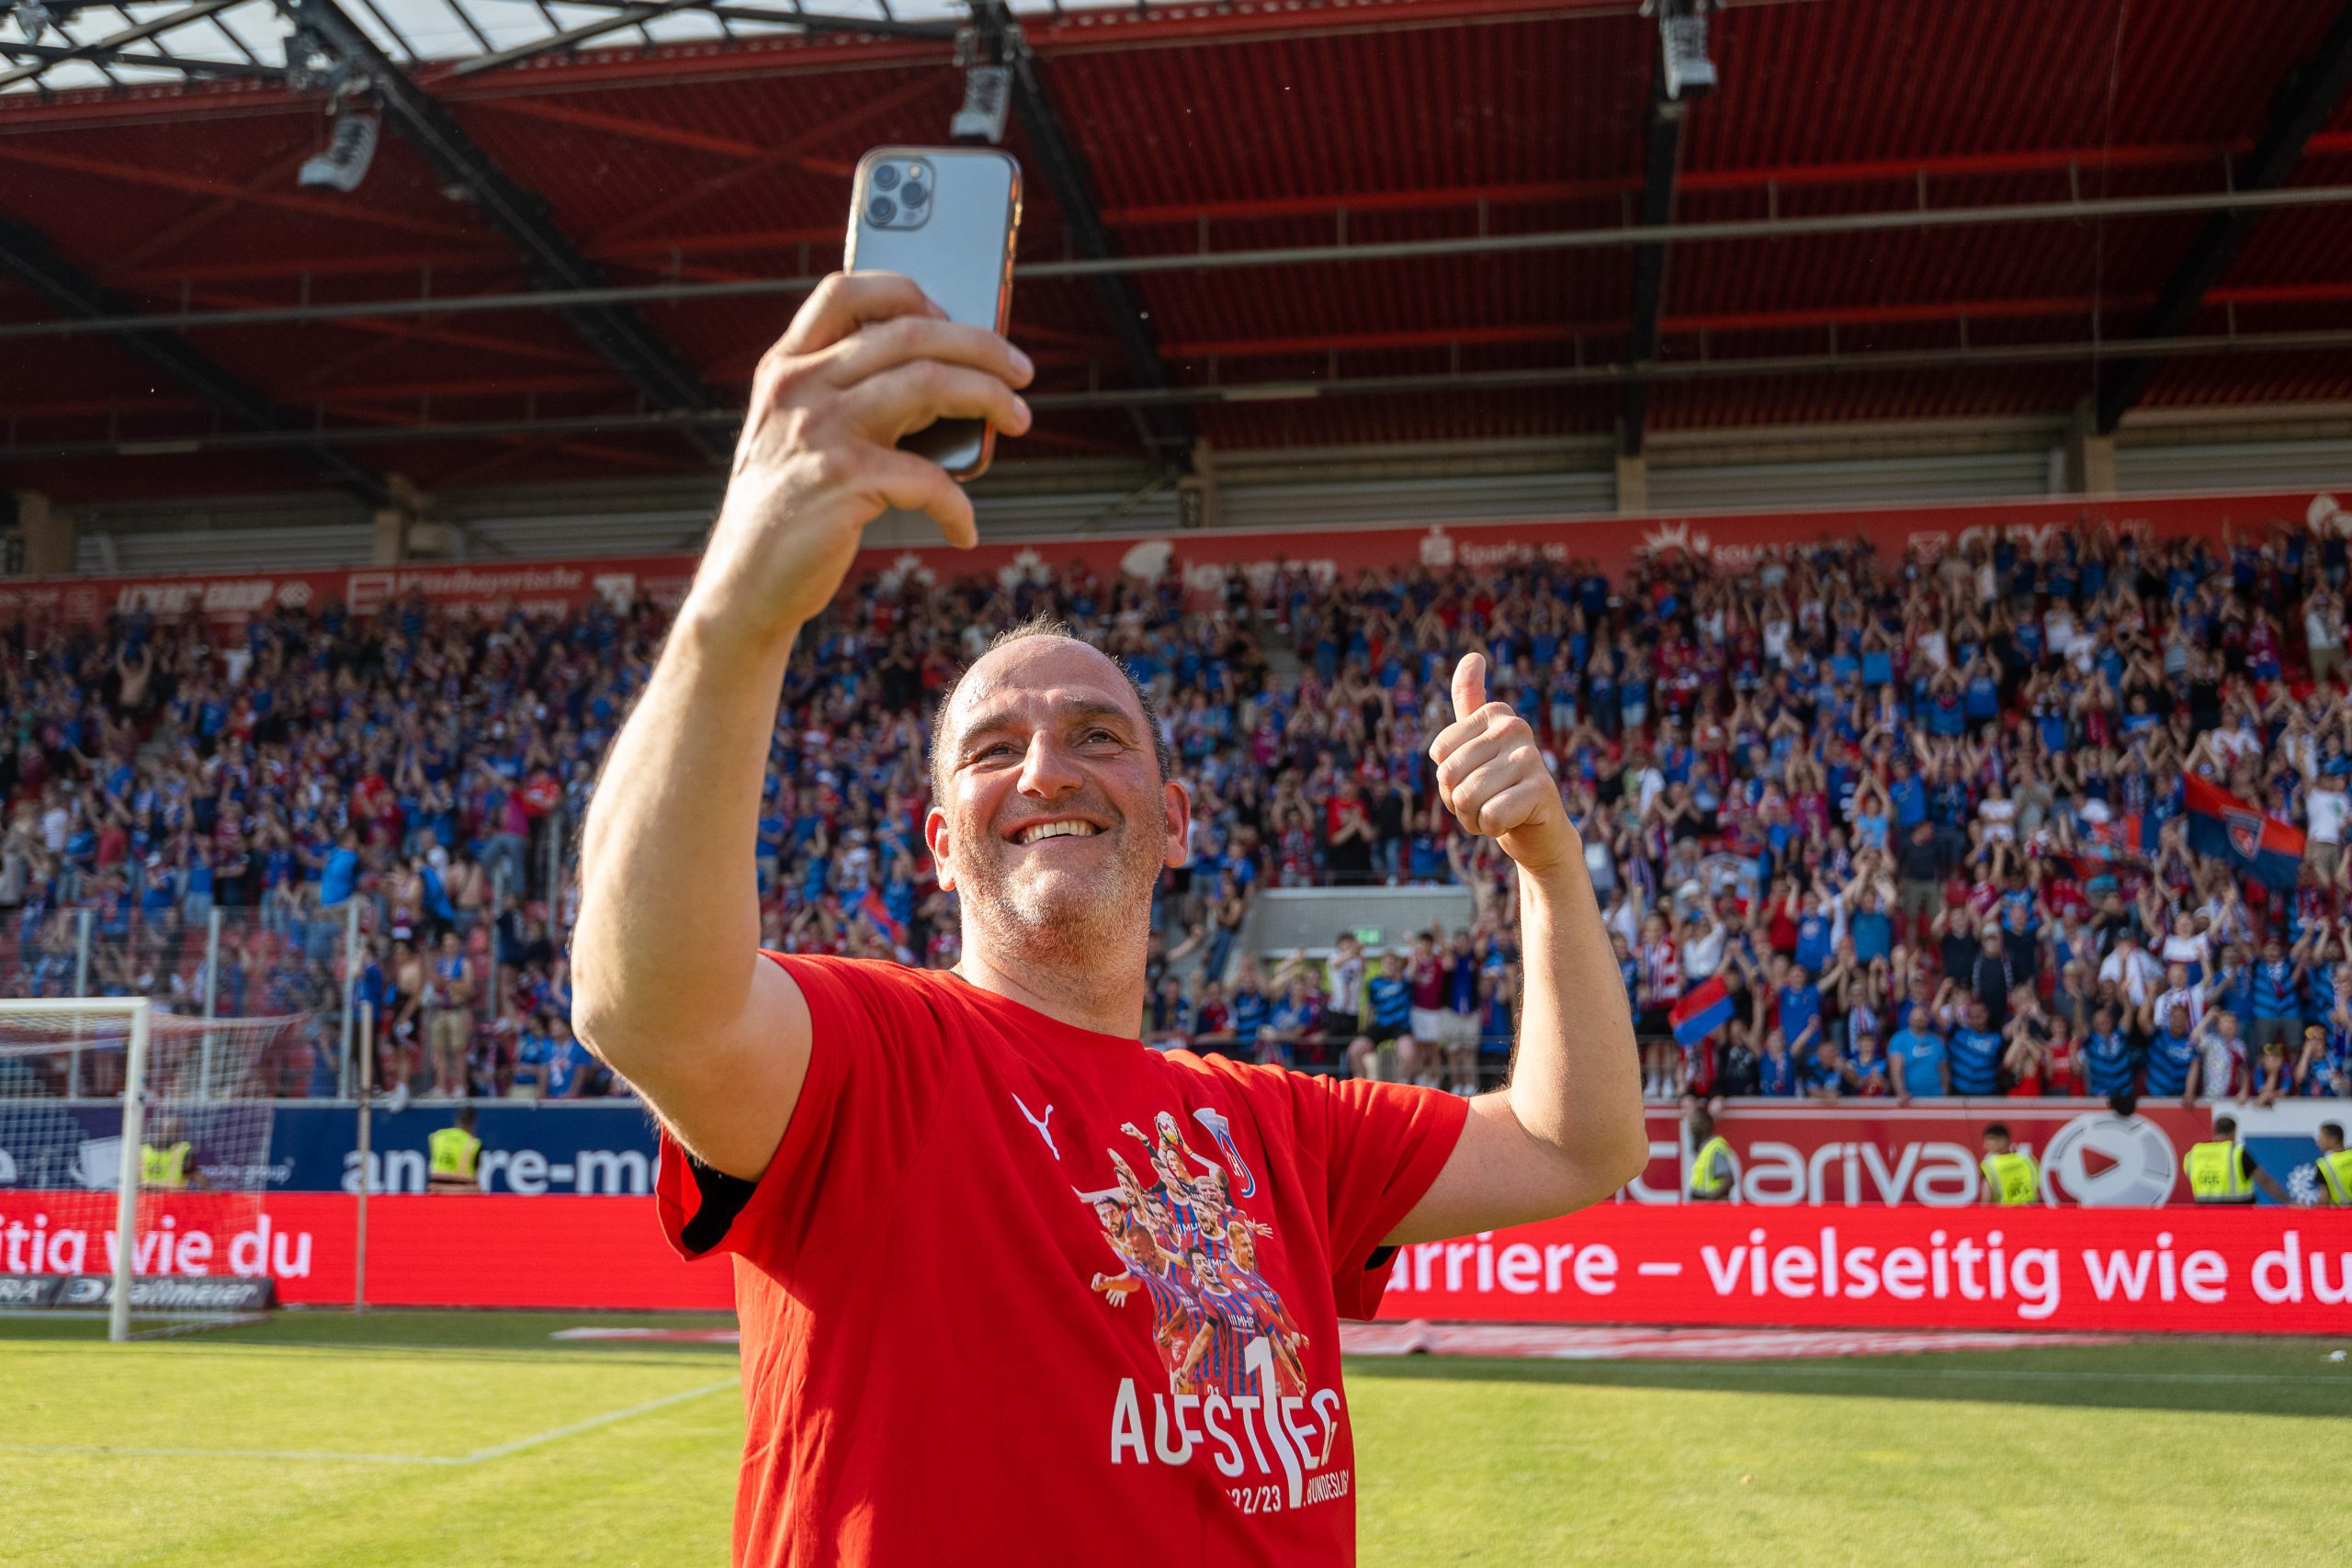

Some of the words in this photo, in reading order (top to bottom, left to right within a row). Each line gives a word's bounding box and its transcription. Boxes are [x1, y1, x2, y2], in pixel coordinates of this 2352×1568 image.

[104, 1214, 213, 1276] wie
[230, 1213, 312, 1278] du
[1384, 1229, 1618, 1295] arriere
[1700, 1227, 2060, 1319] vielseitig
[2082, 1231, 2229, 1303] wie
[2251, 1230, 2352, 1304] du
